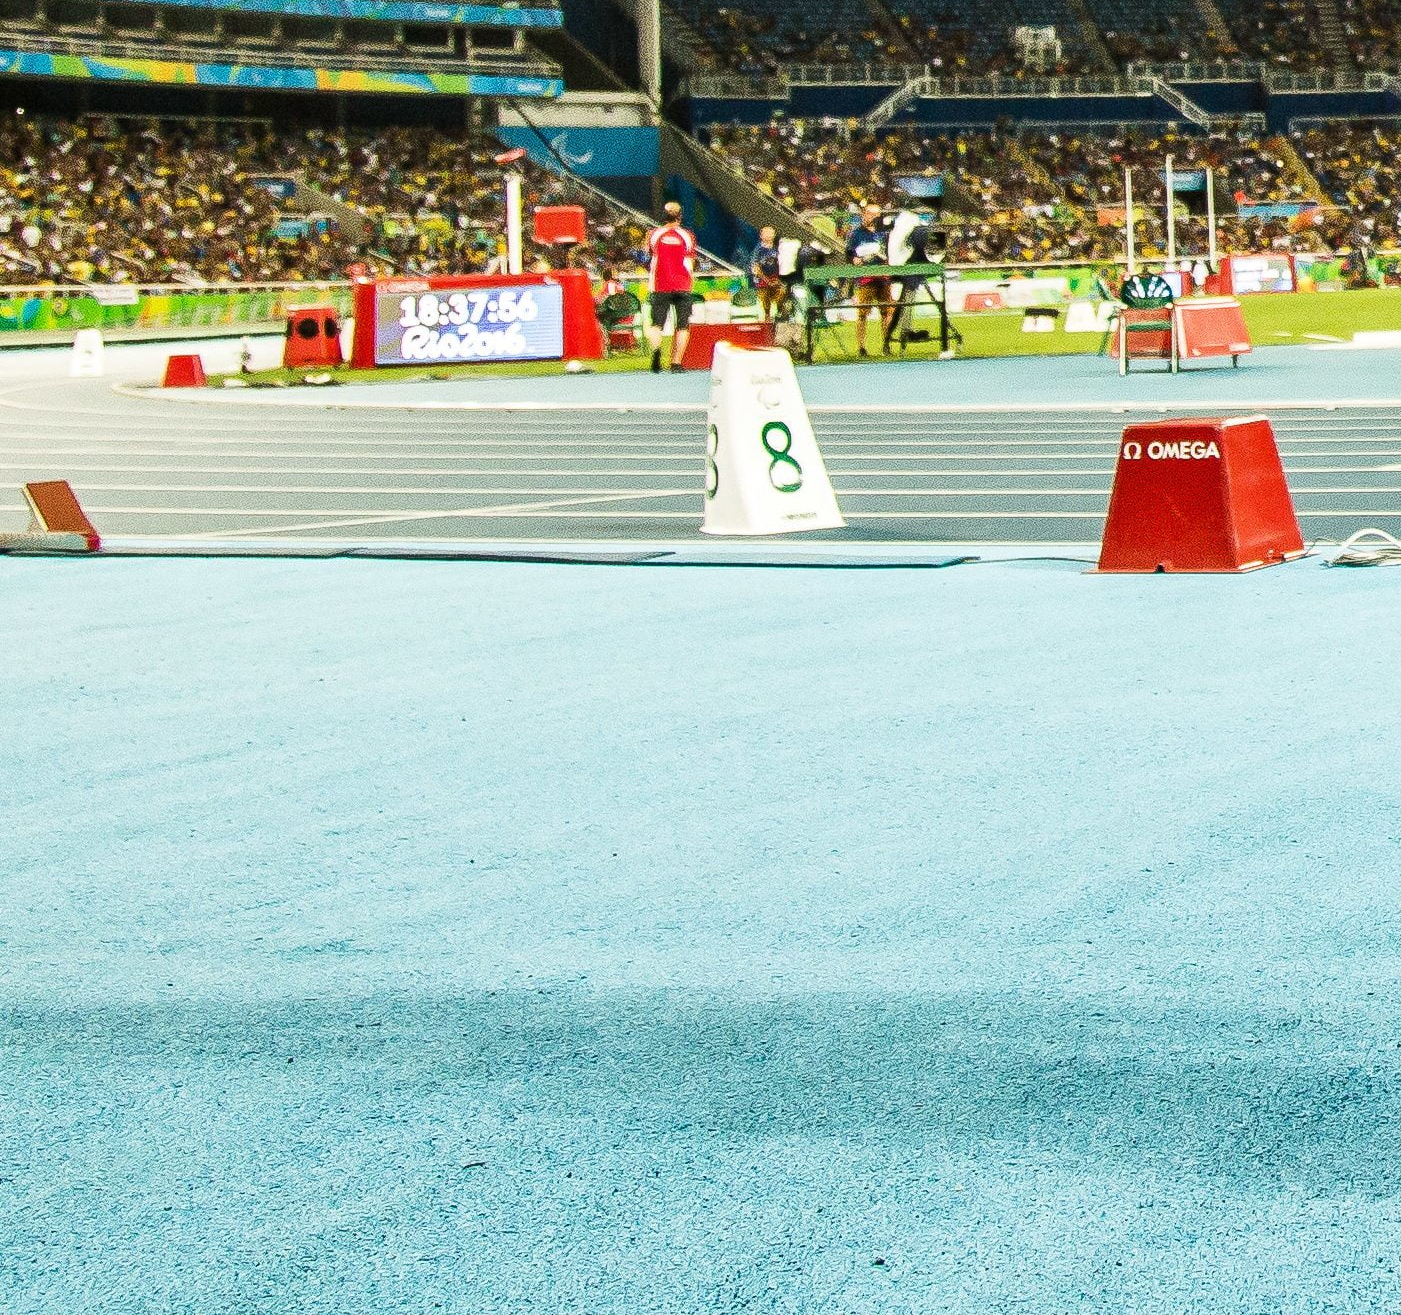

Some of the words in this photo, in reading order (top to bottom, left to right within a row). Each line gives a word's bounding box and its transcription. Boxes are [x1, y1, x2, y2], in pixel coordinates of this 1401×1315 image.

[399, 290, 537, 327] 18:37:56
[761, 421, 803, 493] 8
[1147, 441, 1221, 460] OMEGA
